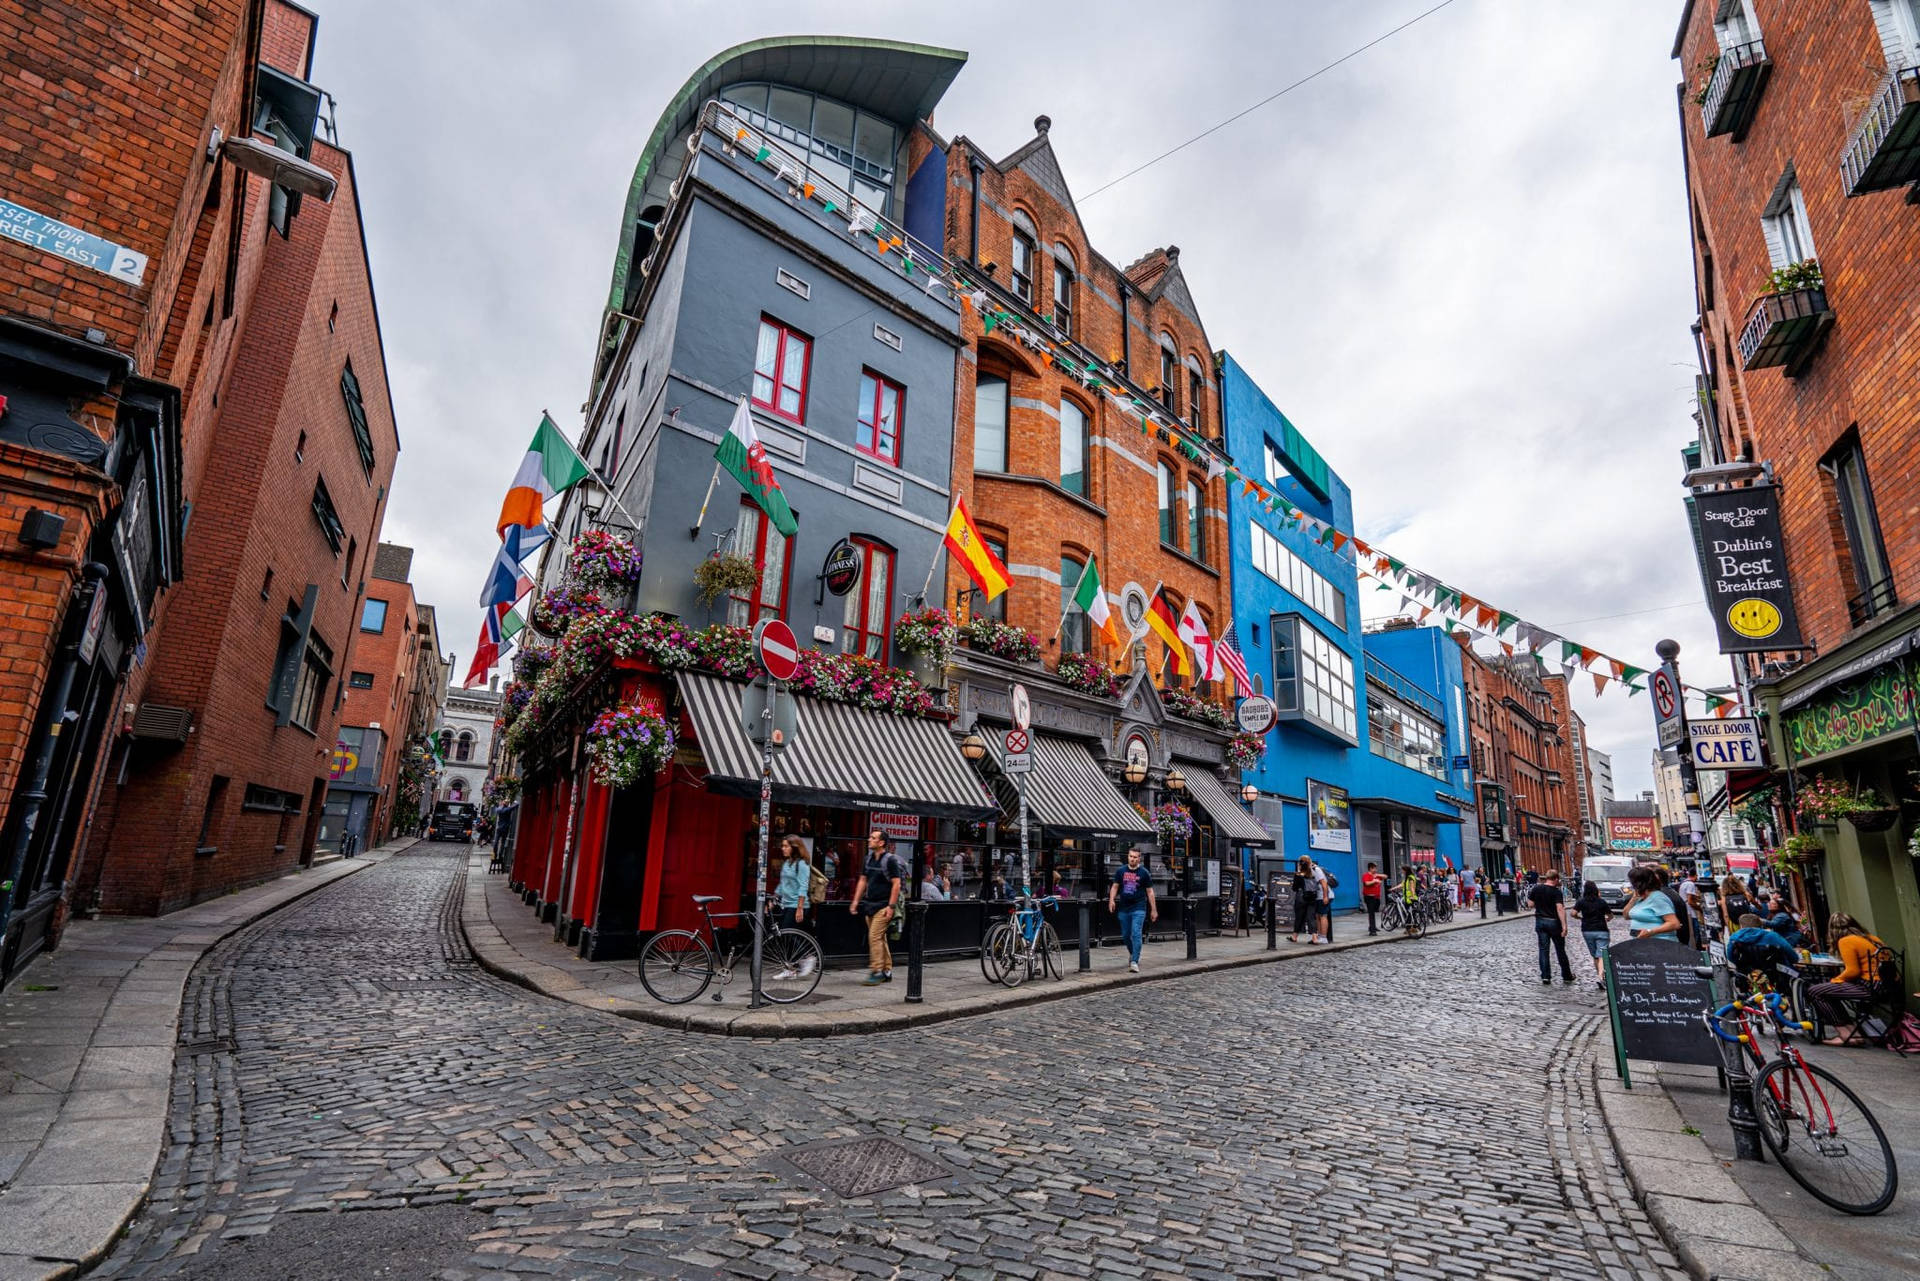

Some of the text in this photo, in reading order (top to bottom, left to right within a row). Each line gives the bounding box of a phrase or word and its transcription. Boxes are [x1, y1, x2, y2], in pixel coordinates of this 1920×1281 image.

[41, 222, 85, 245] THOIR
[55, 241, 101, 265] EAST
[119, 258, 137, 275] 2
[1705, 507, 1768, 523] Stage Door
[1730, 516, 1755, 528] Café
[1713, 536, 1773, 554] Dublin's
[1718, 556, 1774, 577] Best
[1716, 577, 1784, 593] Breakfast
[1691, 724, 1721, 736] STAGE
[1724, 723, 1752, 734] DOOR
[1696, 737, 1756, 763] CAFÉ
[1007, 759, 1018, 767] 24
[872, 811, 918, 826] GUINNESS
[1633, 993, 1650, 1005] Day
[1649, 992, 1668, 1003] Irish
